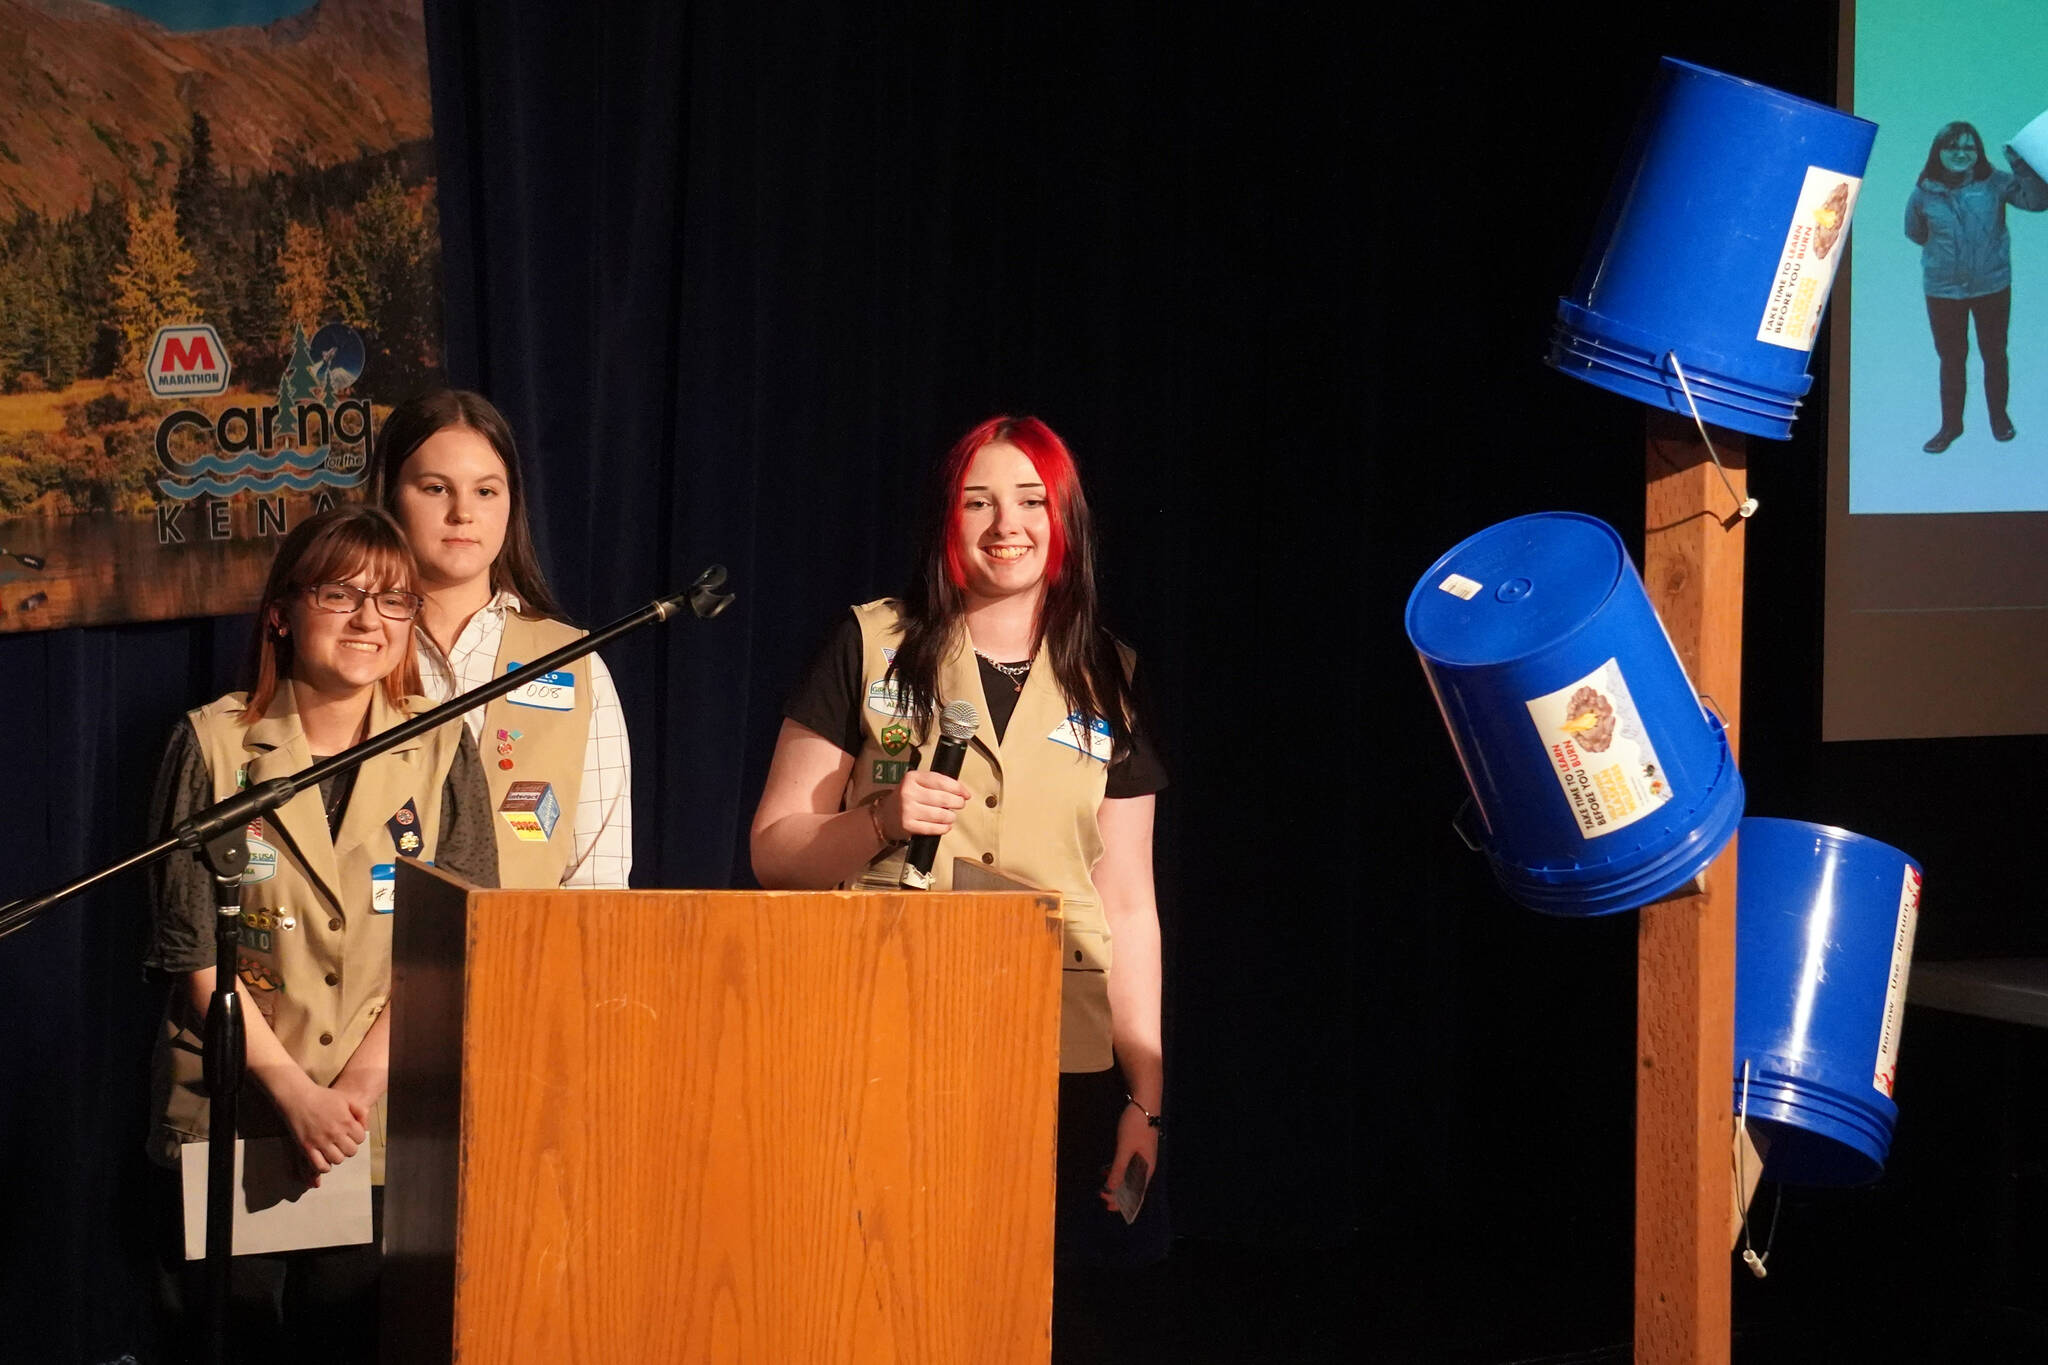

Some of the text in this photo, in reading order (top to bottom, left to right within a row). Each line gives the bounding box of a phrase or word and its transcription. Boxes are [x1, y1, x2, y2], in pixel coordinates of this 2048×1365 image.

[1765, 224, 1803, 331] TAKE TIME TO LEARN
[1774, 291, 1793, 334] BEFORE
[1788, 262, 1801, 287] YOU
[1797, 226, 1812, 260] BURN
[158, 373, 220, 386] MARATHON
[157, 492, 336, 544] KENA
[1551, 744, 1595, 830] TAKE TIME TO LEARN
[1563, 740, 1606, 826] BEFORE YOU BURN
[1880, 903, 1910, 1054] Borrow Use Return
